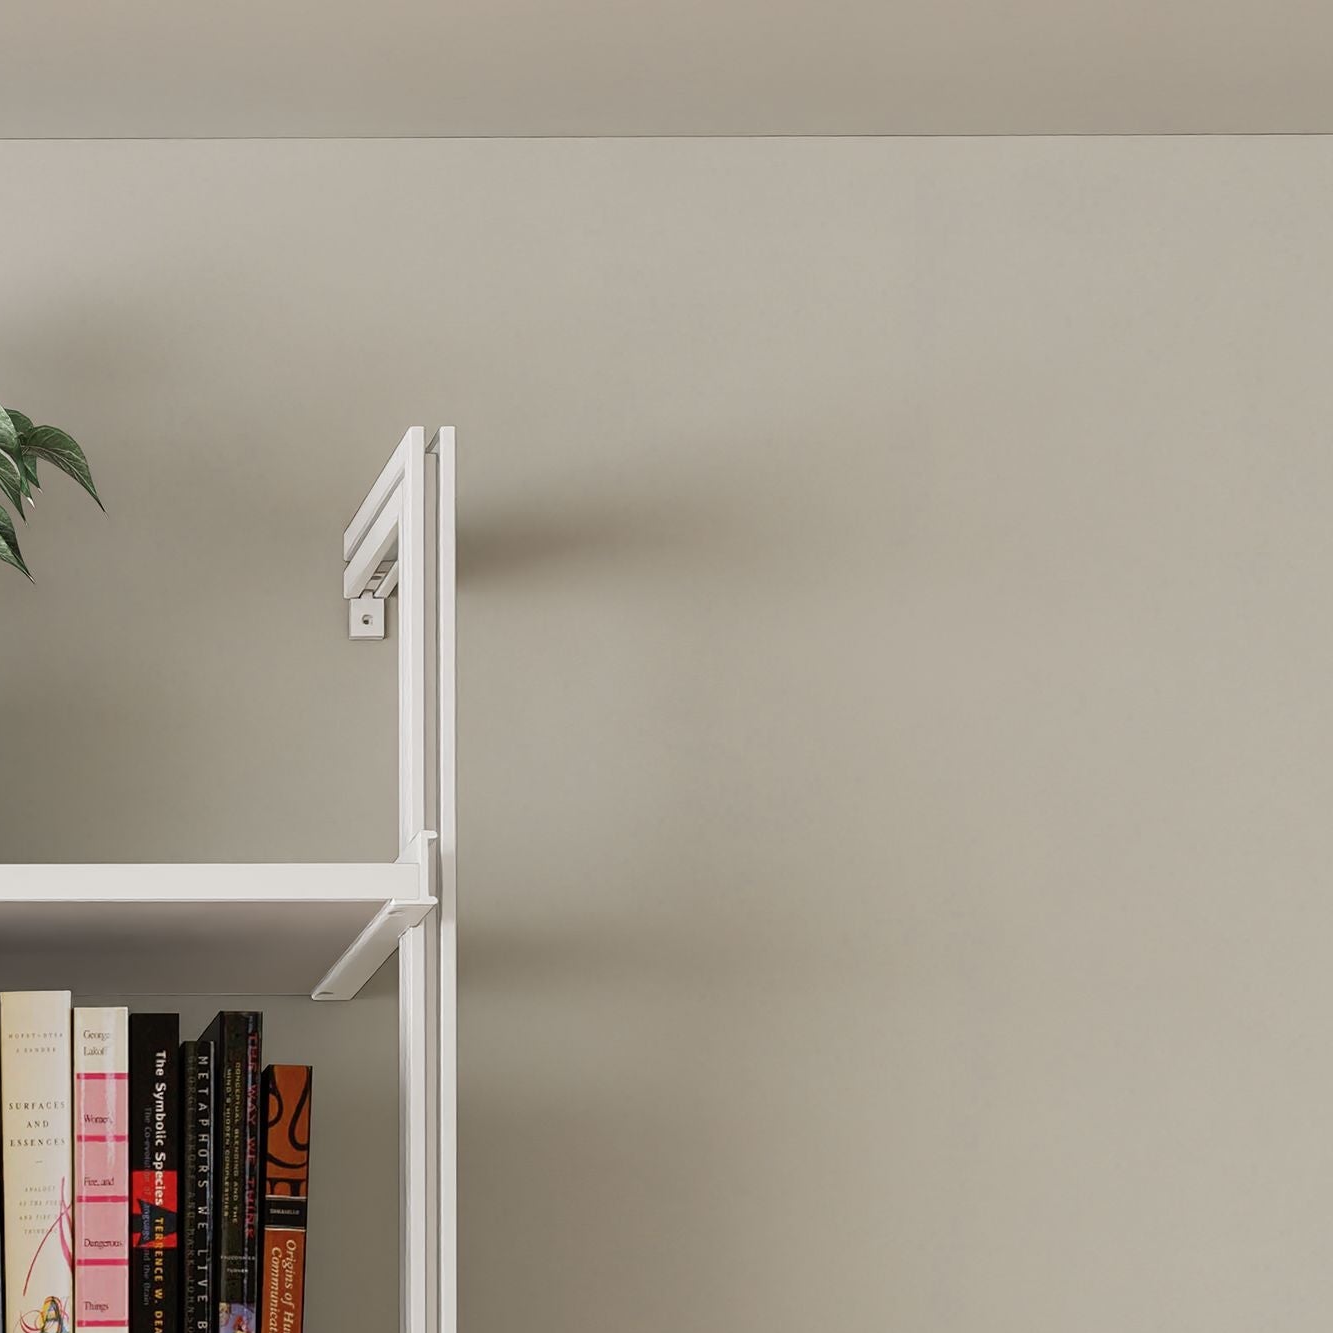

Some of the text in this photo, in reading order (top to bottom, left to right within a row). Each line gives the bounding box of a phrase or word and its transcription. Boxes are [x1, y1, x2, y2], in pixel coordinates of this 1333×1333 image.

[153, 1050, 166, 1206] The Symbolic Species
[198, 1056, 209, 1188] METAPHORS
[198, 1206, 208, 1230] WE
[198, 1248, 208, 1300] LIVE
